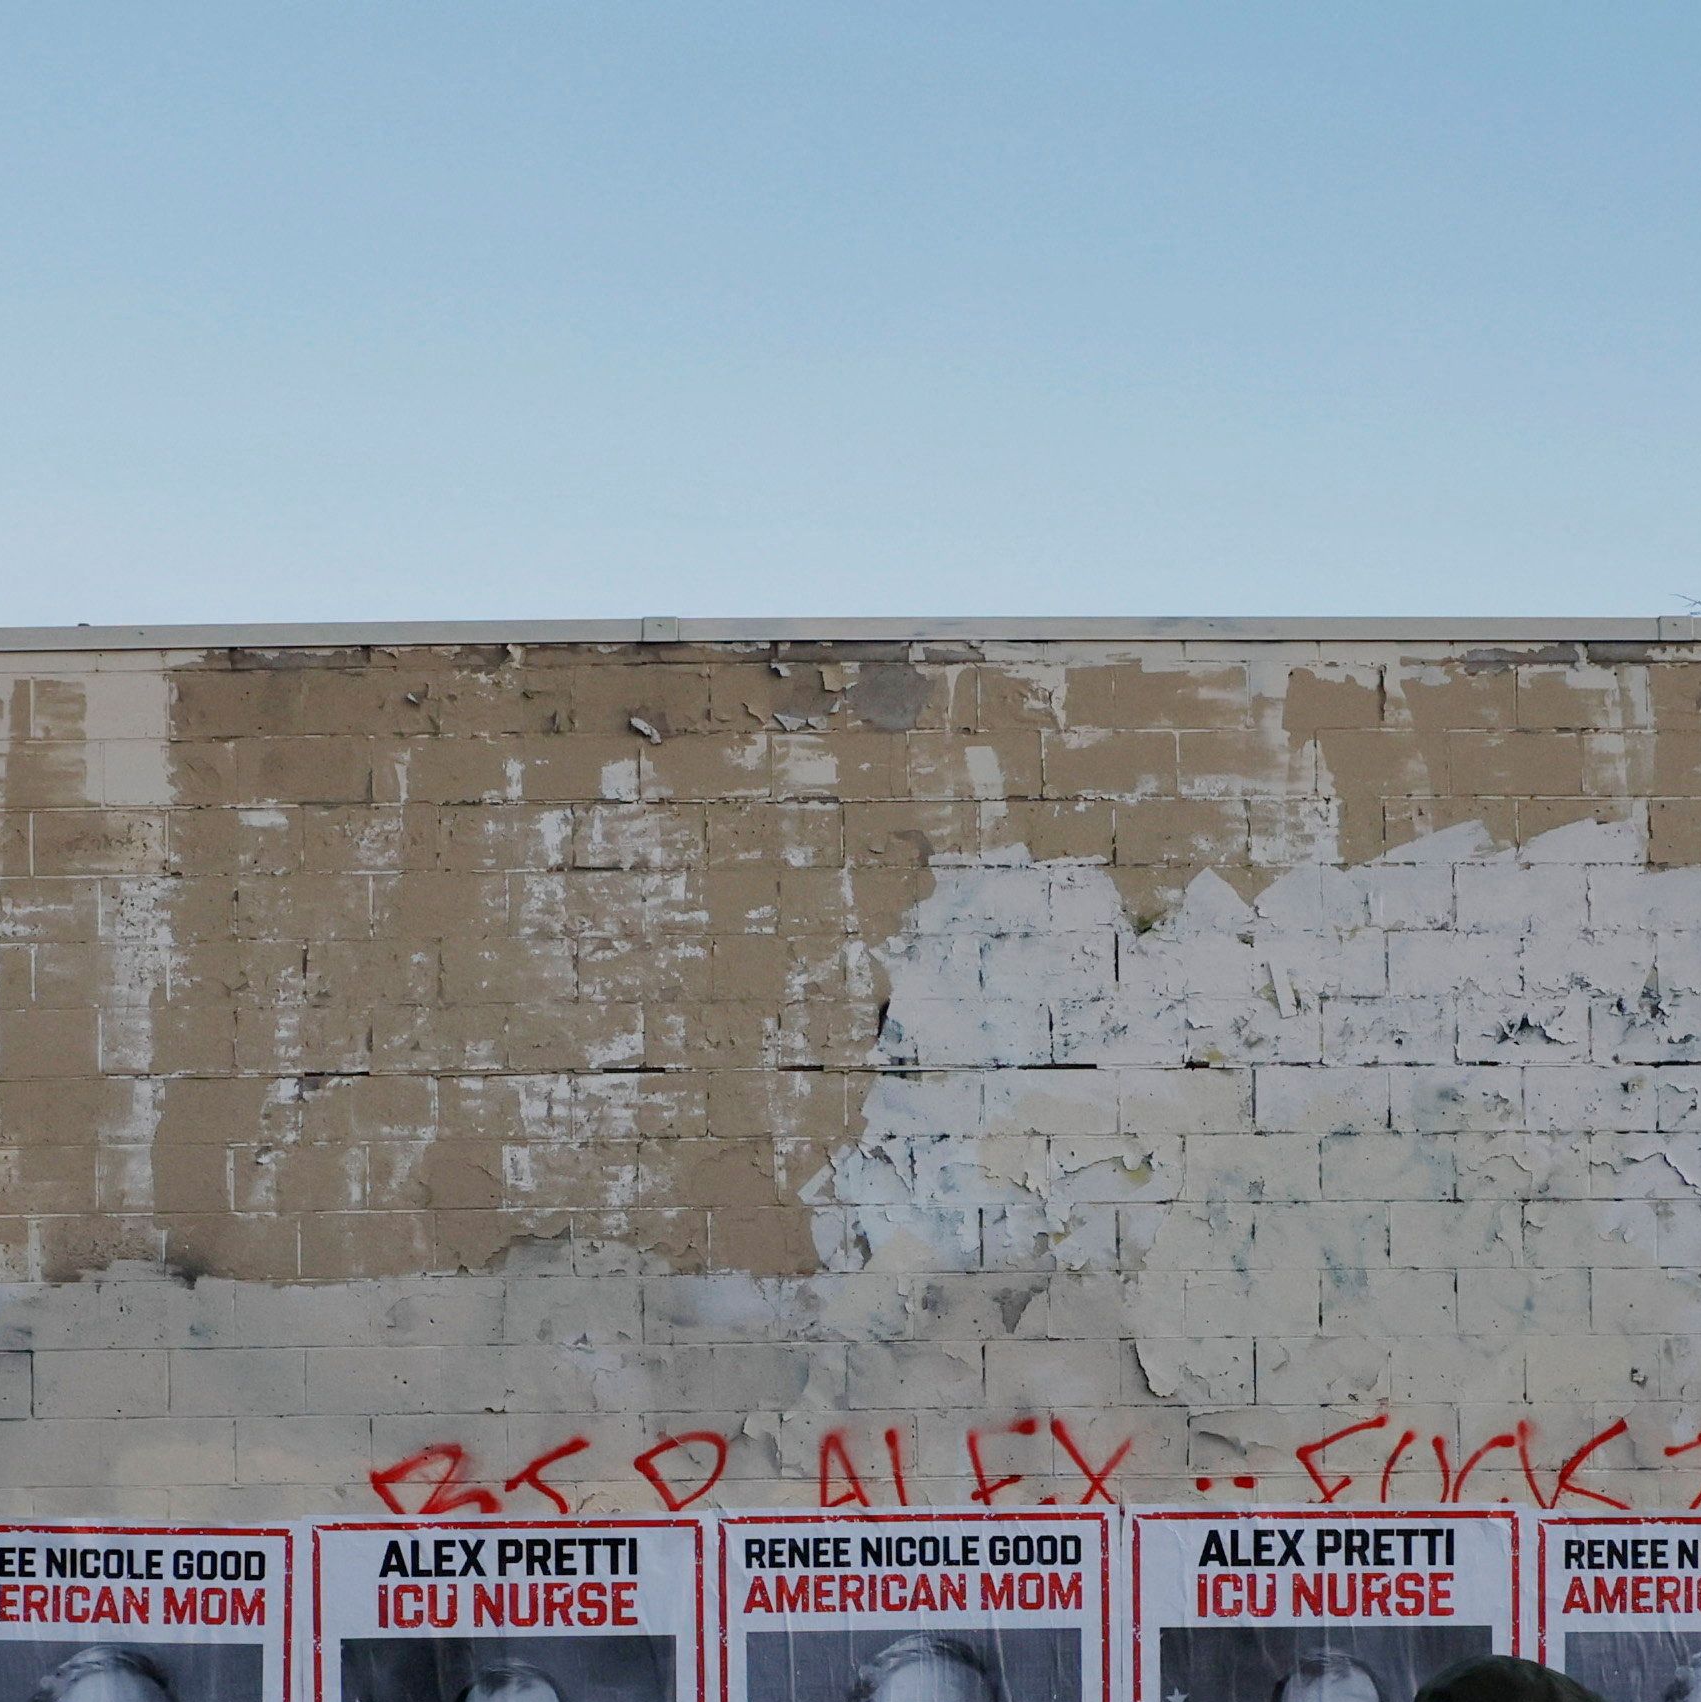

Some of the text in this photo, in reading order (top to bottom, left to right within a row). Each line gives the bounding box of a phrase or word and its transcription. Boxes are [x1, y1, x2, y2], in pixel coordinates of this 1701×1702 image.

[46, 1548, 163, 1579] NICOLE
[173, 1550, 265, 1580] GOOD
[379, 1538, 637, 1577] ALEX PRETTI
[745, 1535, 1081, 1568] RENEE NICOLE GOOD
[1199, 1529, 1454, 1566] ALEX PRETTI
[1565, 1540, 1668, 1569] RENEE
[165, 1588, 265, 1624] MOM
[379, 1582, 637, 1627] ICU NURSE
[745, 1573, 1082, 1613] AMERICAN MOM
[1198, 1573, 1453, 1616] ICU NURSE
